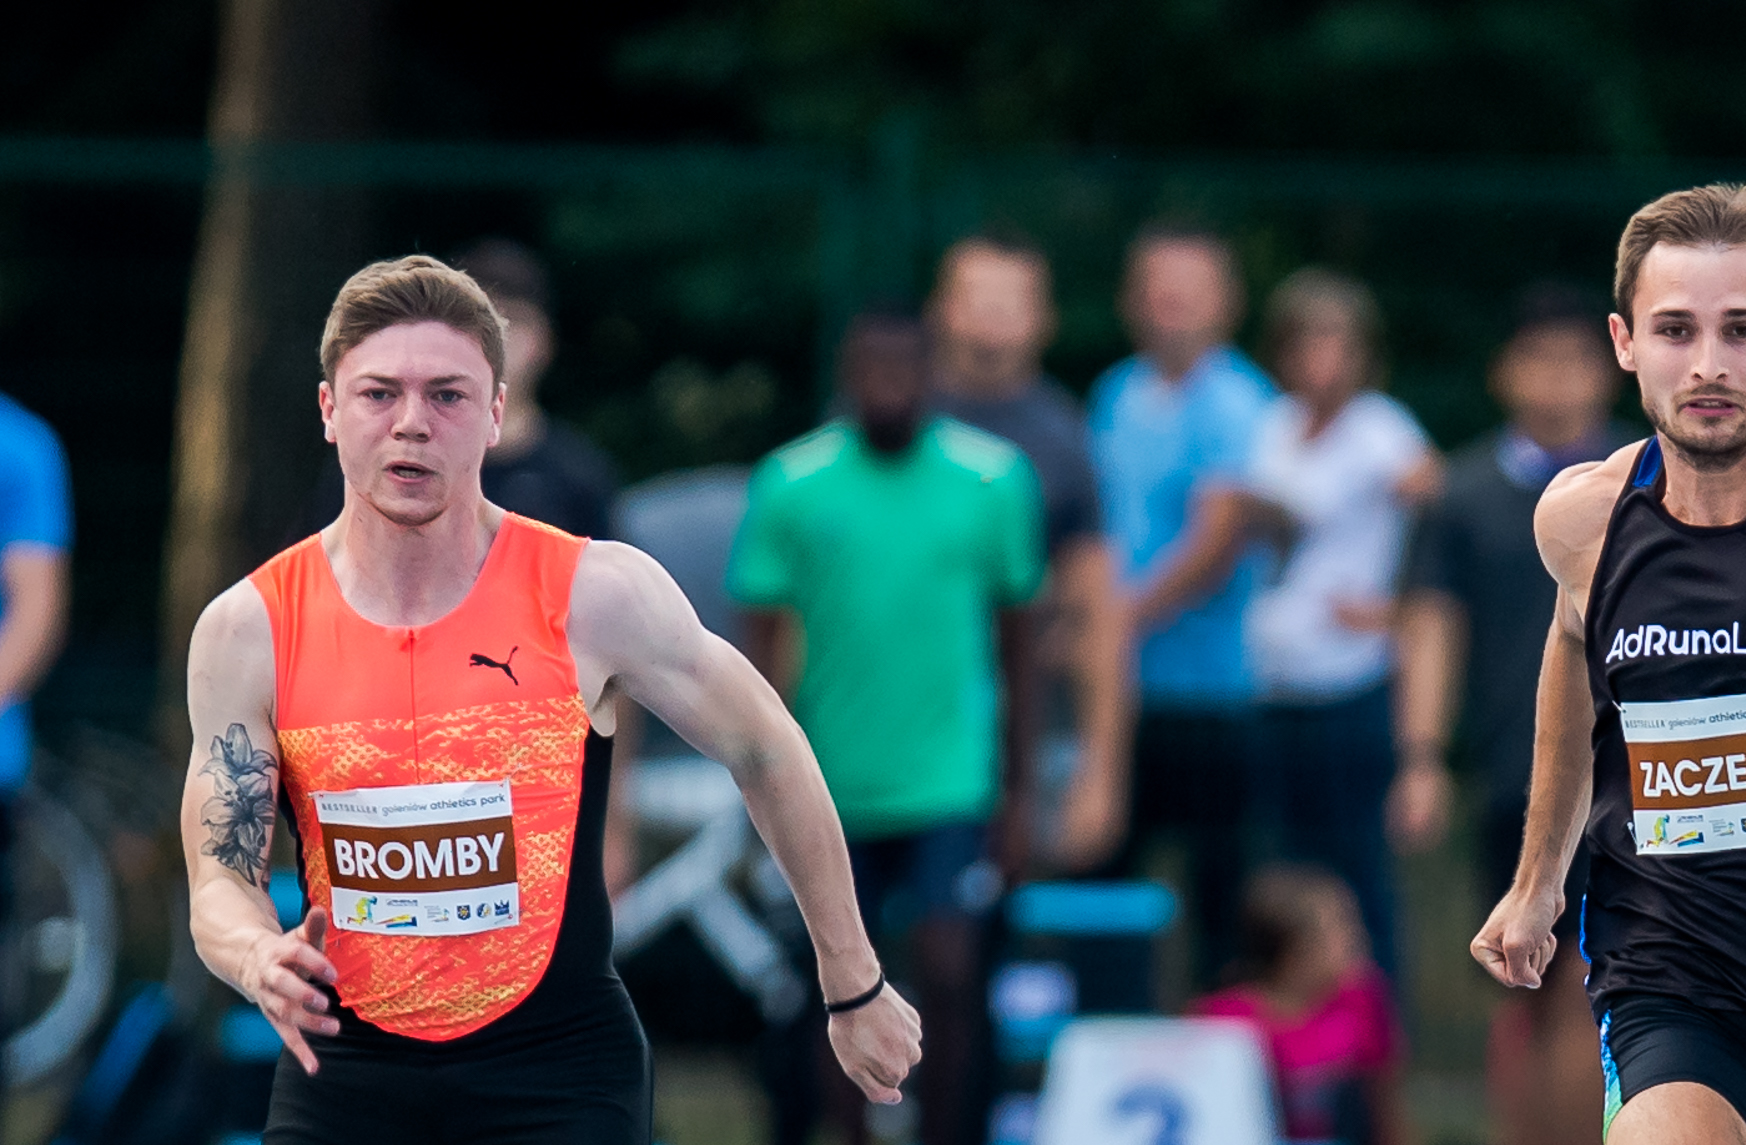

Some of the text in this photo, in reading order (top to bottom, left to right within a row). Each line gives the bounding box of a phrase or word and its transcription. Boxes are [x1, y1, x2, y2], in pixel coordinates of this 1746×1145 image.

[321, 803, 378, 815] BESTSELLER
[429, 796, 477, 811] athletics
[480, 793, 506, 807] park
[333, 832, 505, 880] BROMBY
